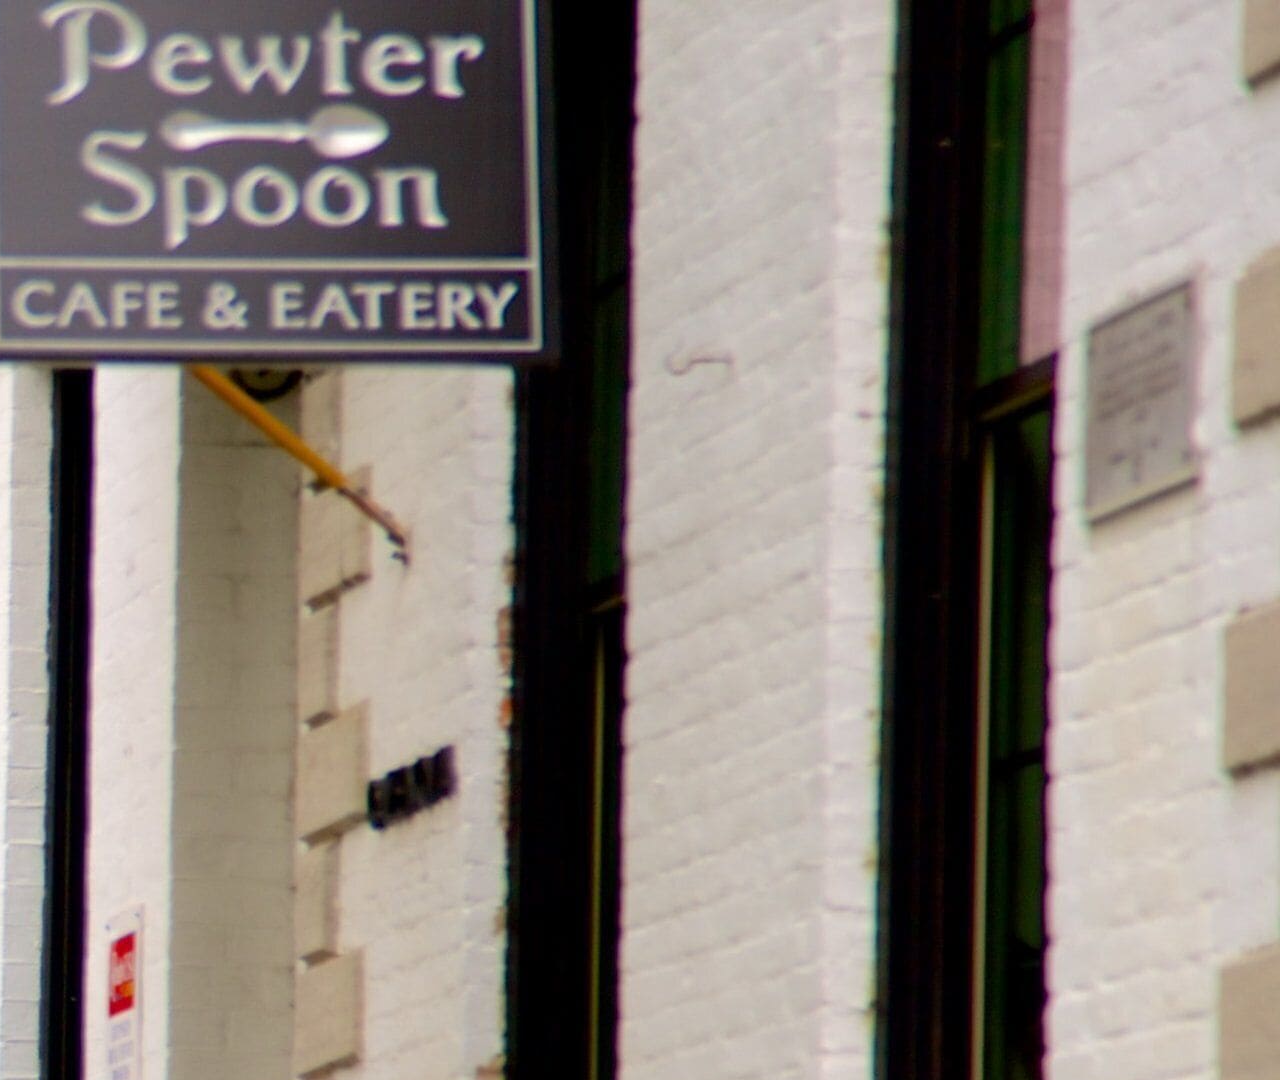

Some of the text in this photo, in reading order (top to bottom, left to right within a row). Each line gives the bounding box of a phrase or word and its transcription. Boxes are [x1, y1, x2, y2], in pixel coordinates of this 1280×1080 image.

[39, 0, 485, 105] Pewter
[80, 131, 447, 250] Spoon
[10, 280, 520, 331] CAFE & EATERY
